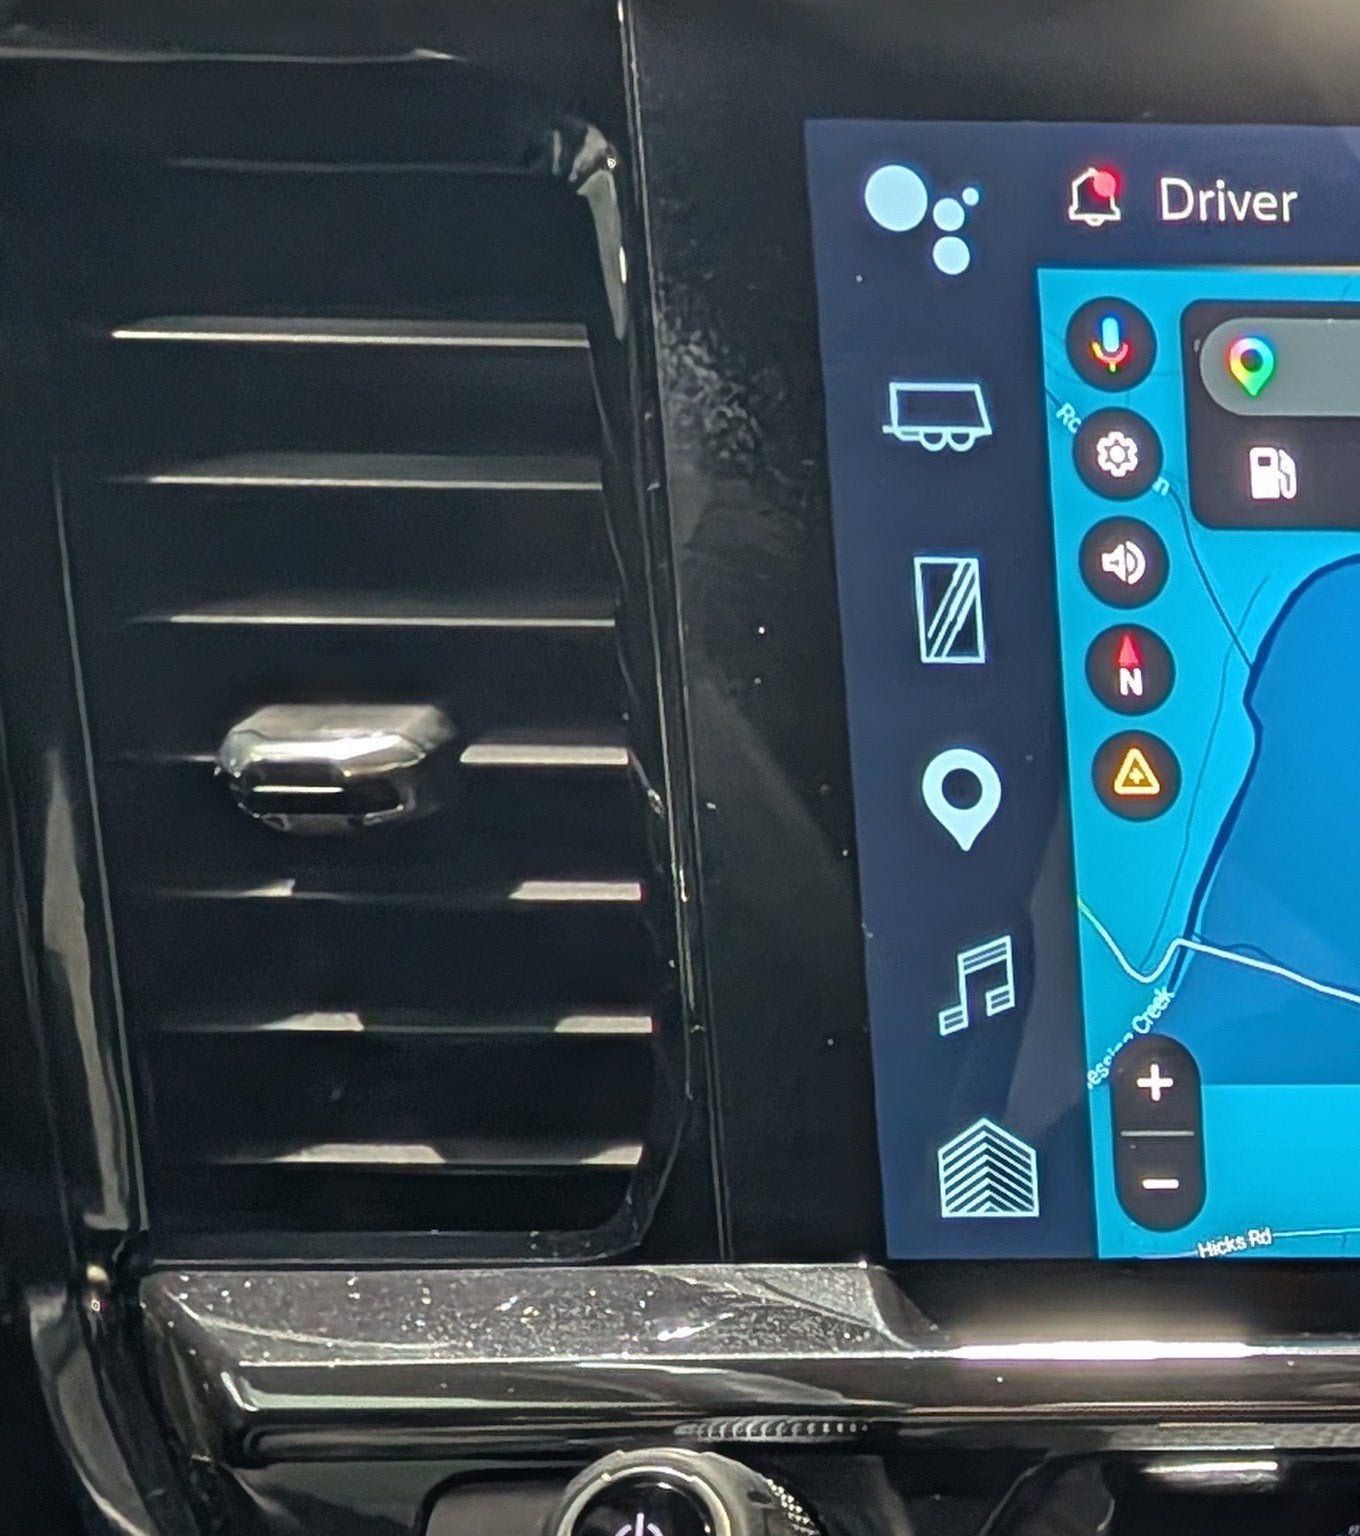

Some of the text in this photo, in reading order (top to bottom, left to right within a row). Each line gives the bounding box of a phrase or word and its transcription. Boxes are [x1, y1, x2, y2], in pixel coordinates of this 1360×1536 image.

[1160, 176, 1299, 226] Driver
[1118, 667, 1143, 697] N
[1131, 986, 1176, 1034] Creek
[1198, 1227, 1273, 1258] Hicks Rd
